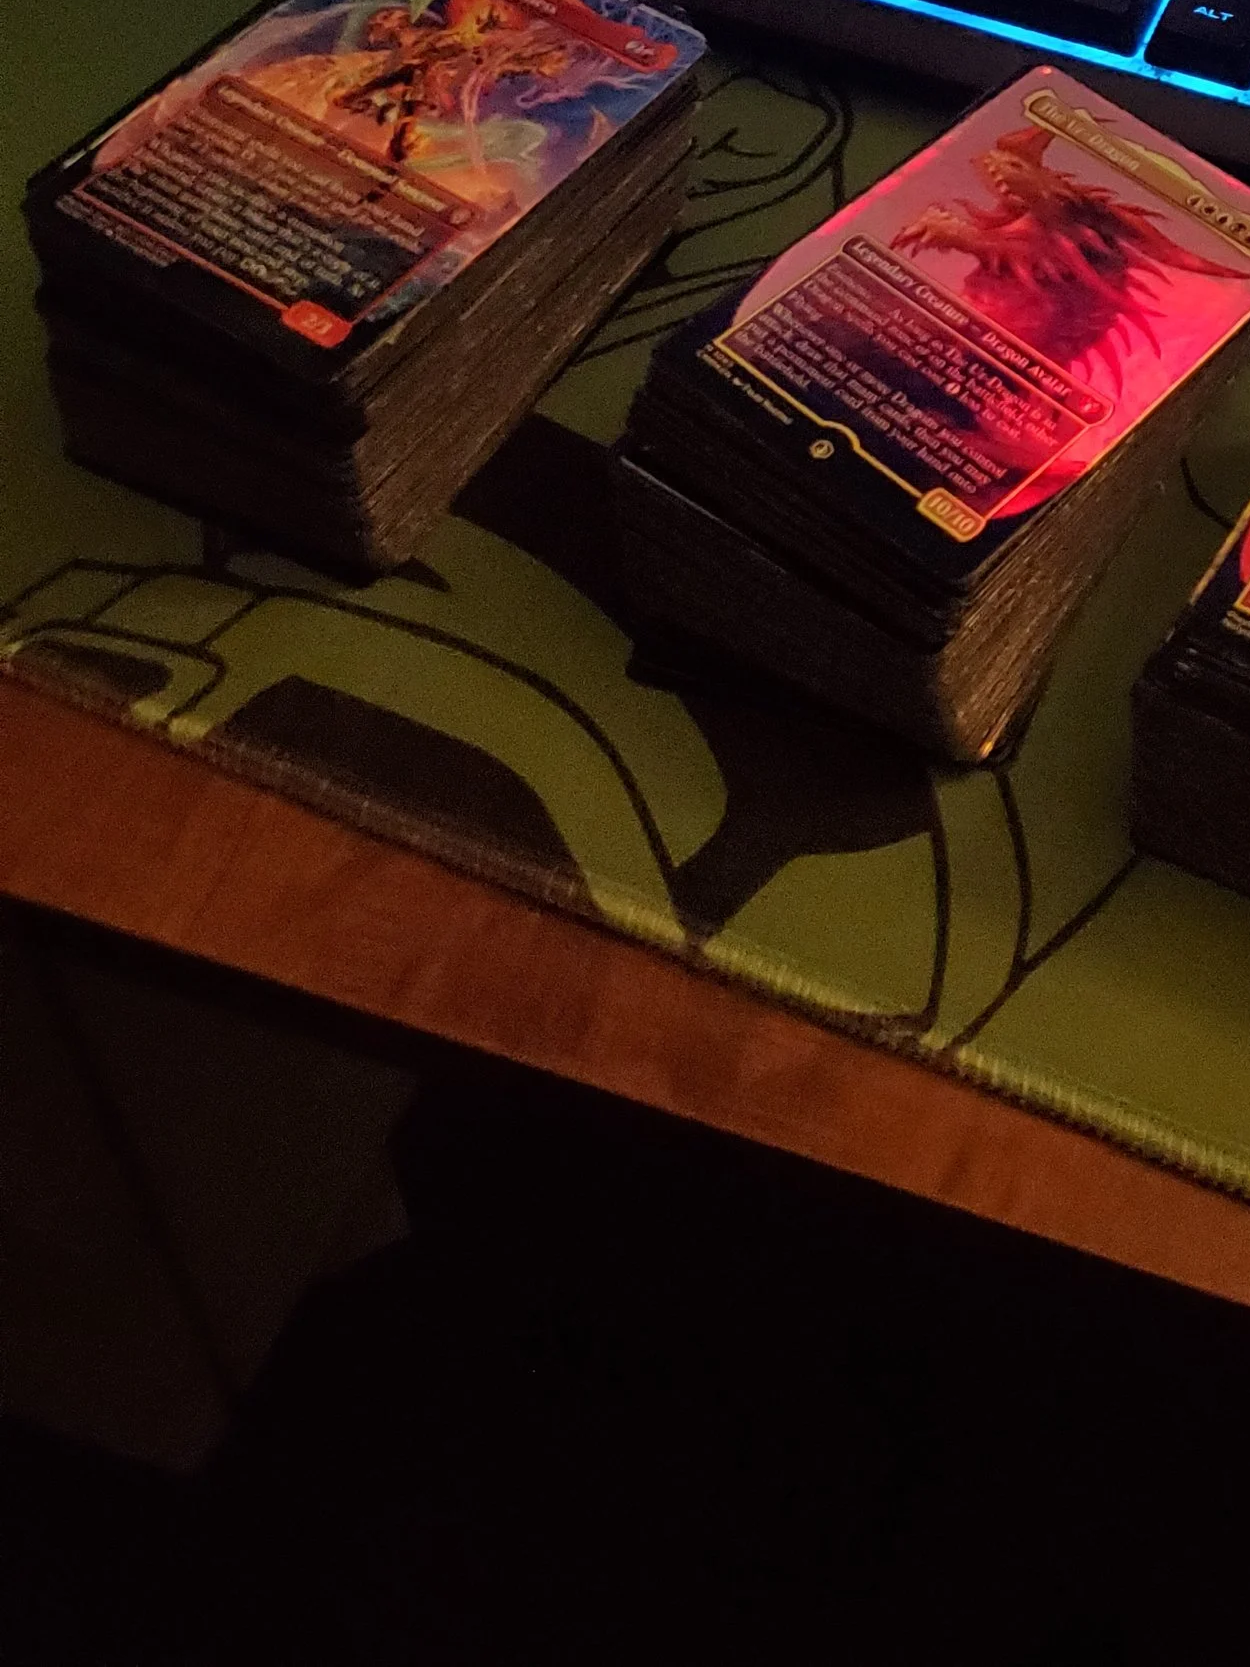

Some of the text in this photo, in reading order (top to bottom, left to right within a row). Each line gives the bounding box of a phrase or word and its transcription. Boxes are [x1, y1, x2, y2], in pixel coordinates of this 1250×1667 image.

[1192, 4, 1235, 23] ALT
[848, 240, 920, 292] Legendary
[924, 492, 979, 535] 10/10
